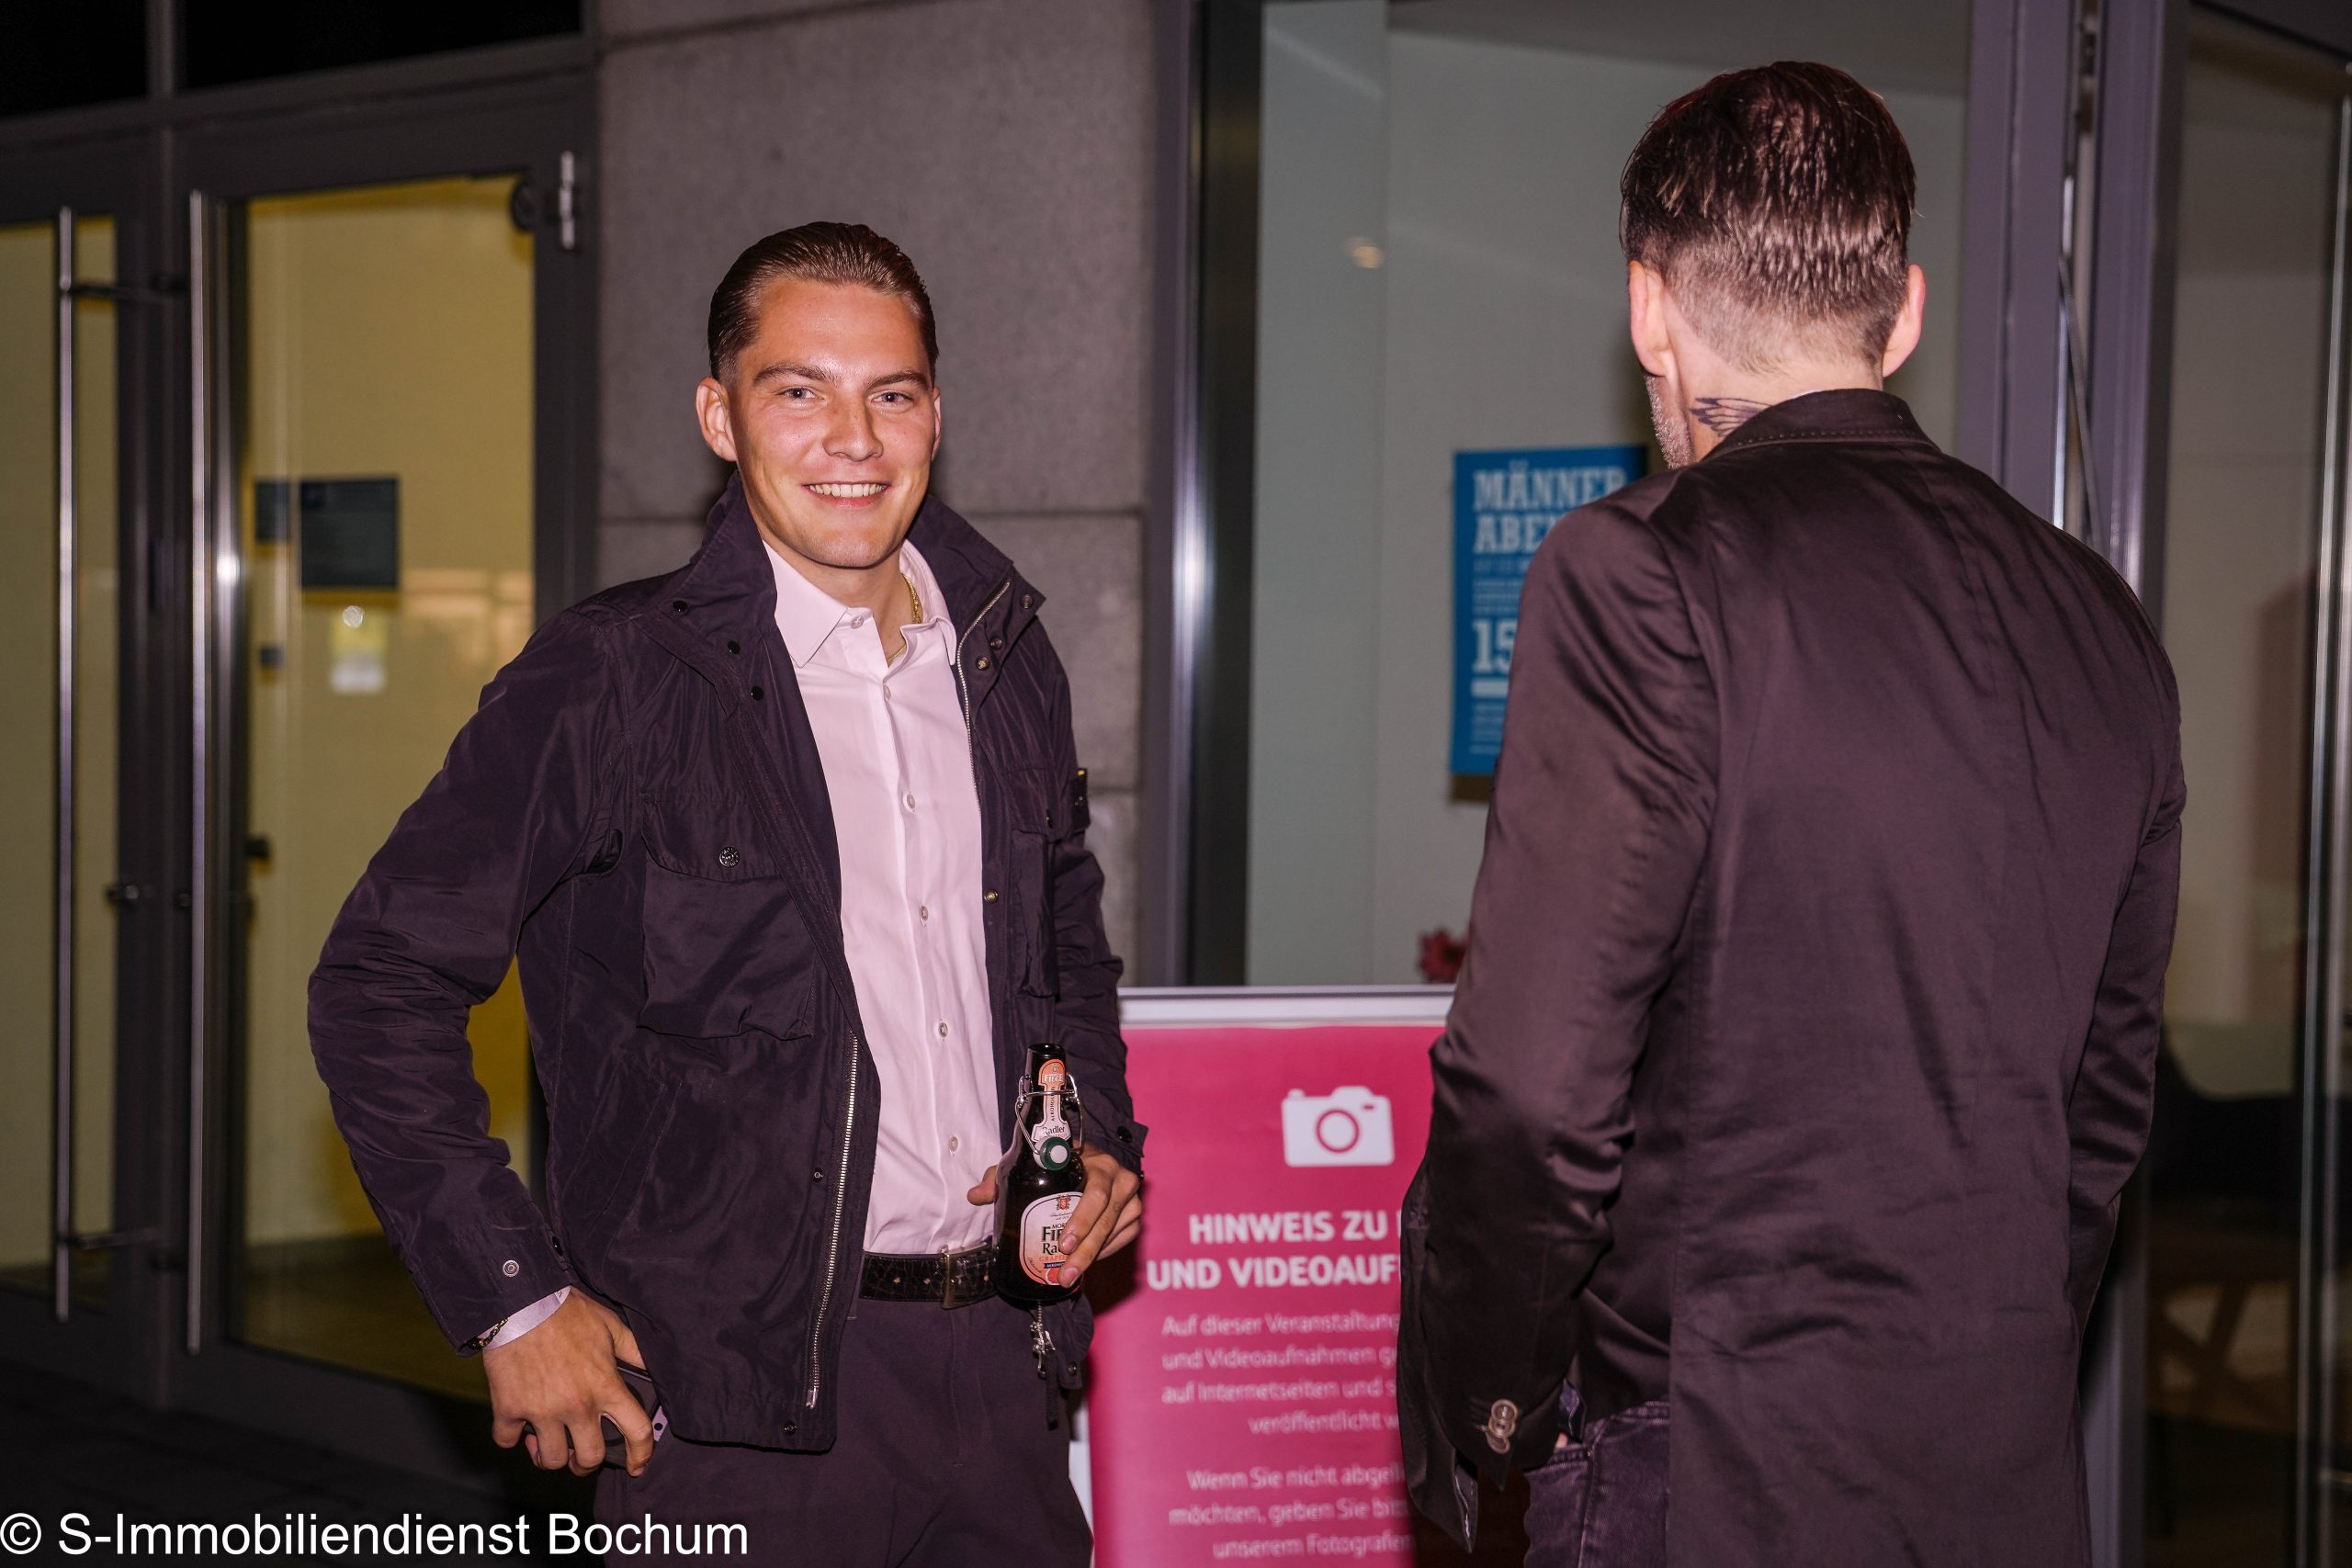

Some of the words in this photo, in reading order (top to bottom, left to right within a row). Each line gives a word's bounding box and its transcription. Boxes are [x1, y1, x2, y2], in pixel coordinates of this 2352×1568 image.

[1473, 512, 1563, 554] ABE
[1190, 1212, 1336, 1244] HINWEIS
[1342, 1210, 1388, 1240] ZU
[1147, 1258, 1221, 1291] UND
[1227, 1255, 1401, 1288] VIDEOAUF
[1162, 1314, 1197, 1337] Auf
[1200, 1314, 1262, 1336] dieser
[1162, 1348, 1204, 1370] und
[1204, 1346, 1376, 1368] Videoaufnahmen
[1161, 1380, 1194, 1404] auf
[1197, 1380, 1340, 1403] Internetseiten
[1341, 1376, 1384, 1398] und
[1248, 1410, 1382, 1434] veröffentlicht
[1186, 1469, 1248, 1490] Wenn
[1250, 1466, 1283, 1489] Sie
[1286, 1465, 1338, 1487] nicht
[1269, 1500, 1336, 1528] geben
[1336, 1497, 1370, 1520] Sie
[1213, 1540, 1304, 1559] unserem
